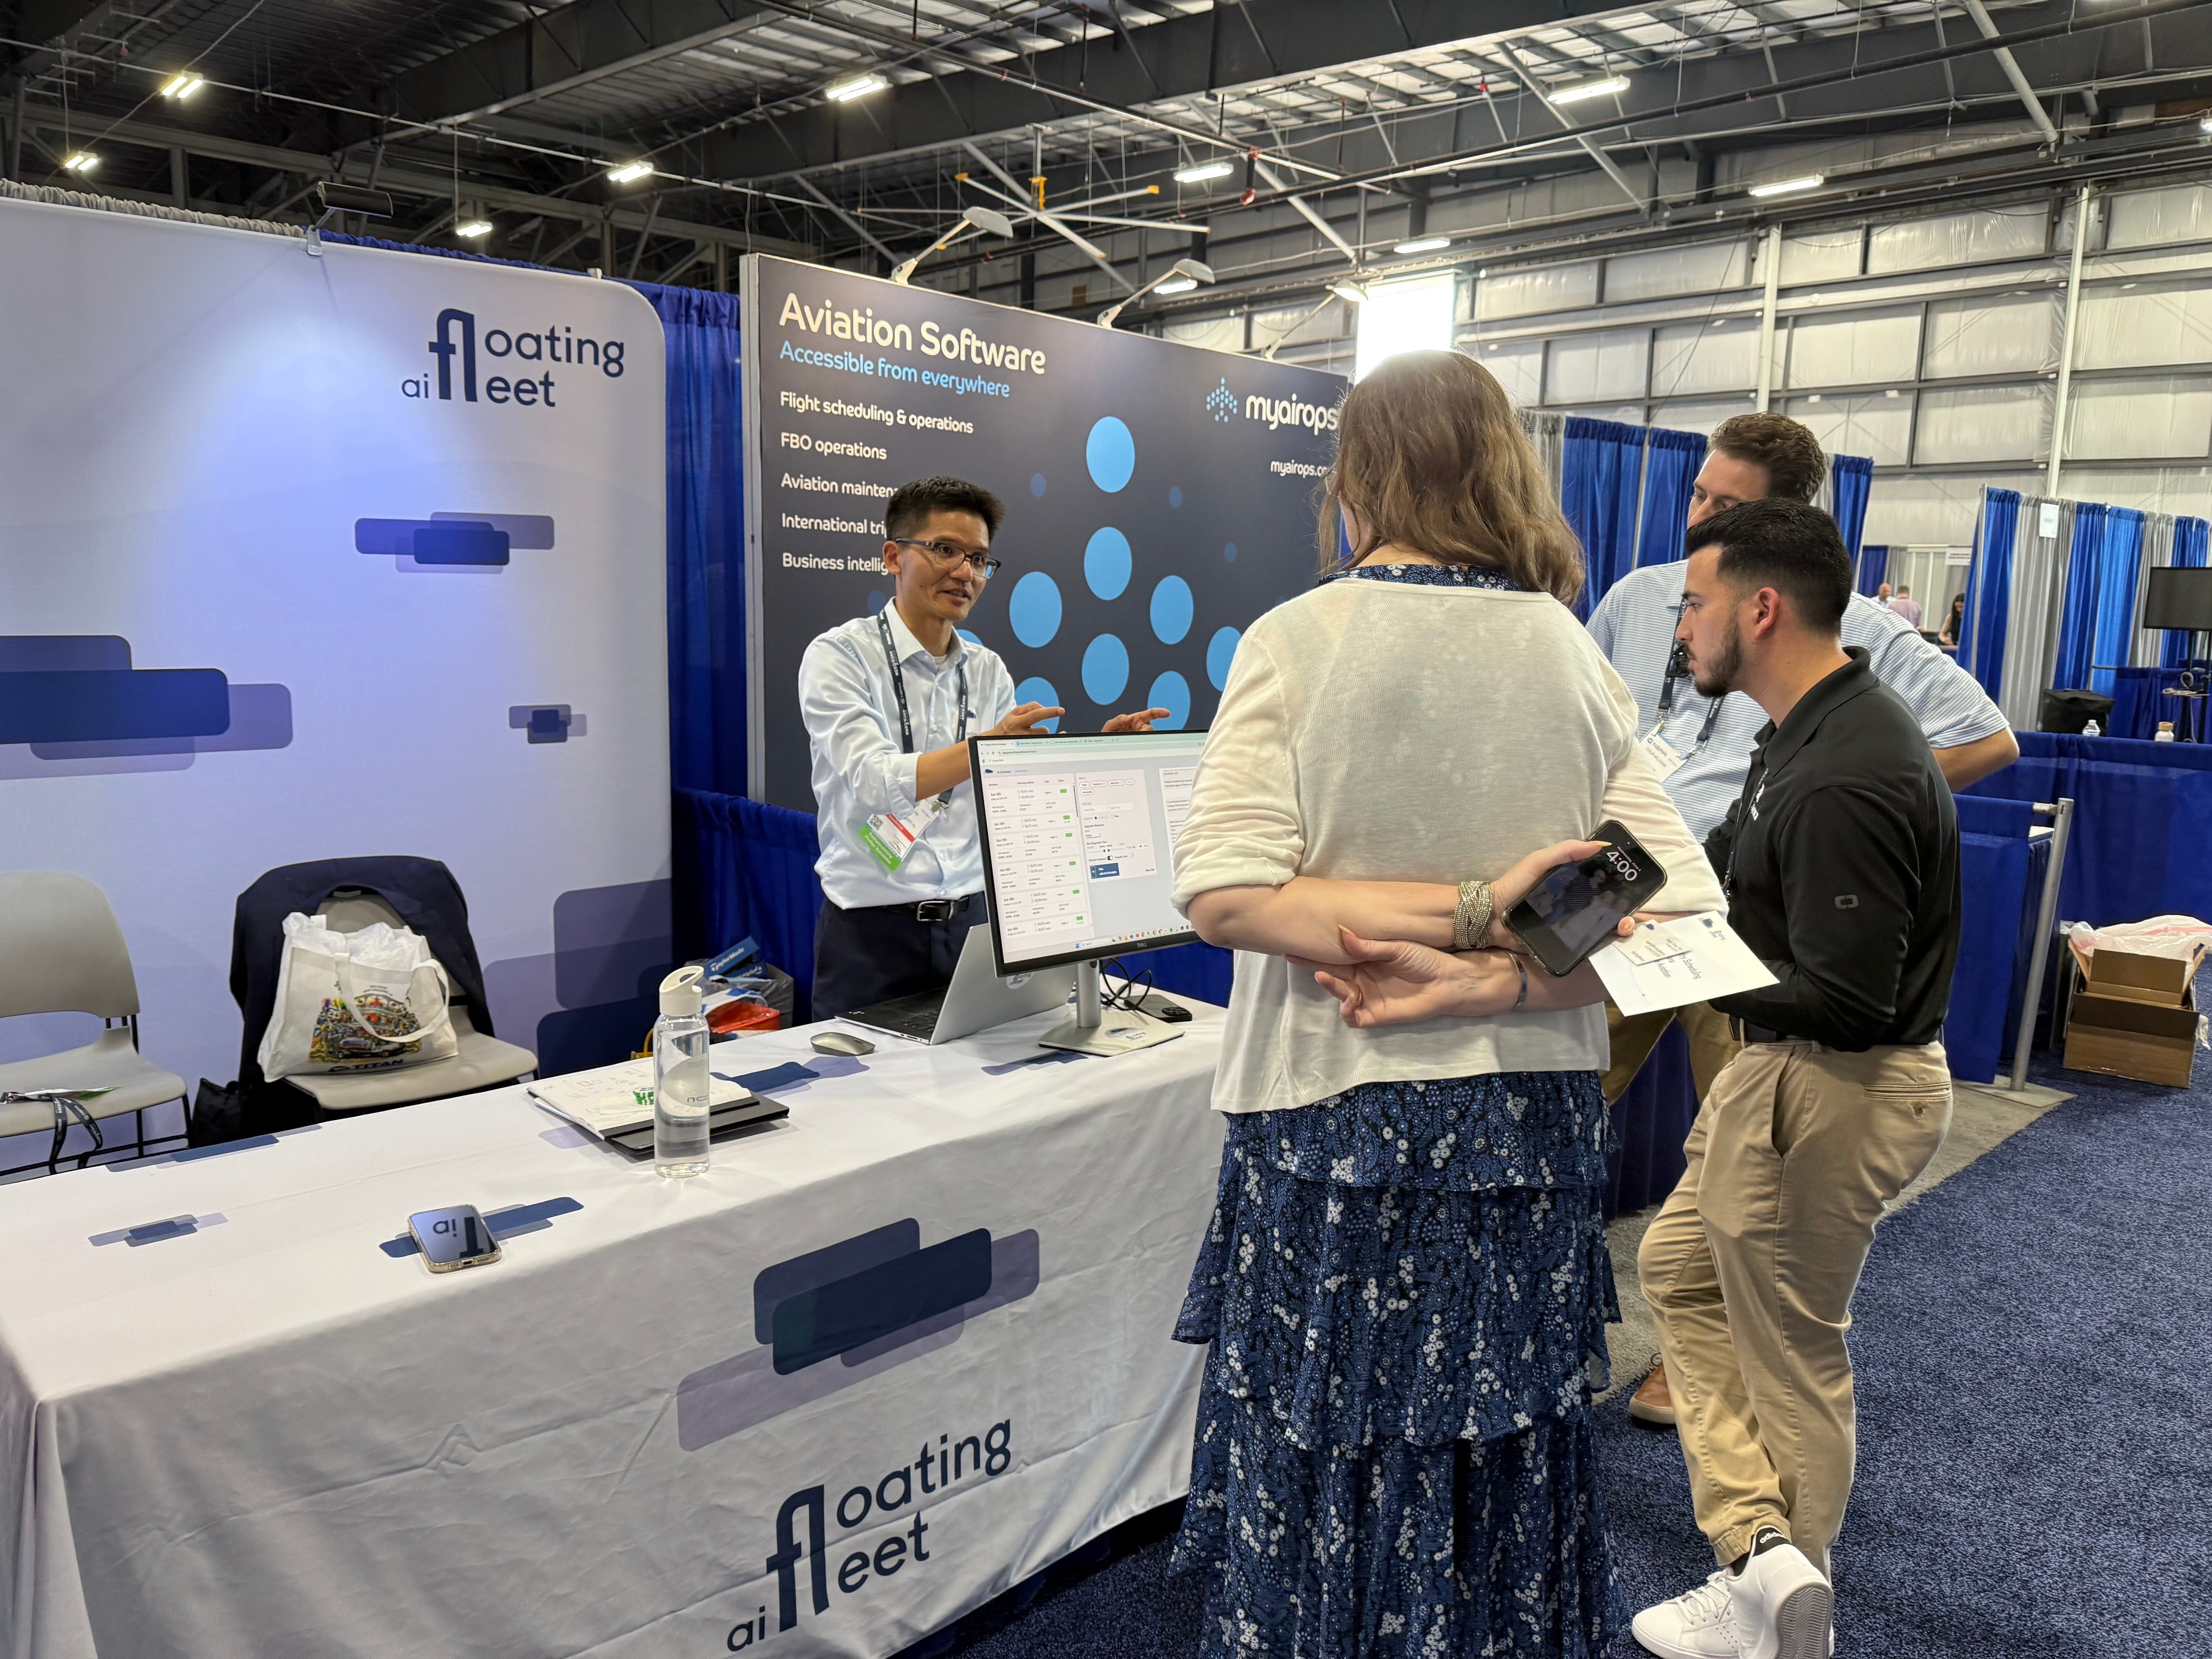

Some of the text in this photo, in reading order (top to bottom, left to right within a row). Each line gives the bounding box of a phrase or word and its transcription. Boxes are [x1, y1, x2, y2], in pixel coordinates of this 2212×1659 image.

[779, 293, 1046, 374] Aviation Software
[780, 340, 1010, 398] Accessible from everywhere
[401, 373, 429, 399] ai
[780, 392, 974, 434] Flight scheduling & operations
[1245, 393, 1338, 436] myairops
[781, 432, 887, 460] FBO operations
[1270, 459, 1329, 479] myairops.co
[781, 472, 899, 498] Aviation mainten
[781, 513, 887, 539] International tri
[782, 552, 889, 576] Business intellig
[1606, 852, 1638, 881] 4:00
[353, 1059, 404, 1070] TITAN
[727, 1606, 766, 1652] ai
